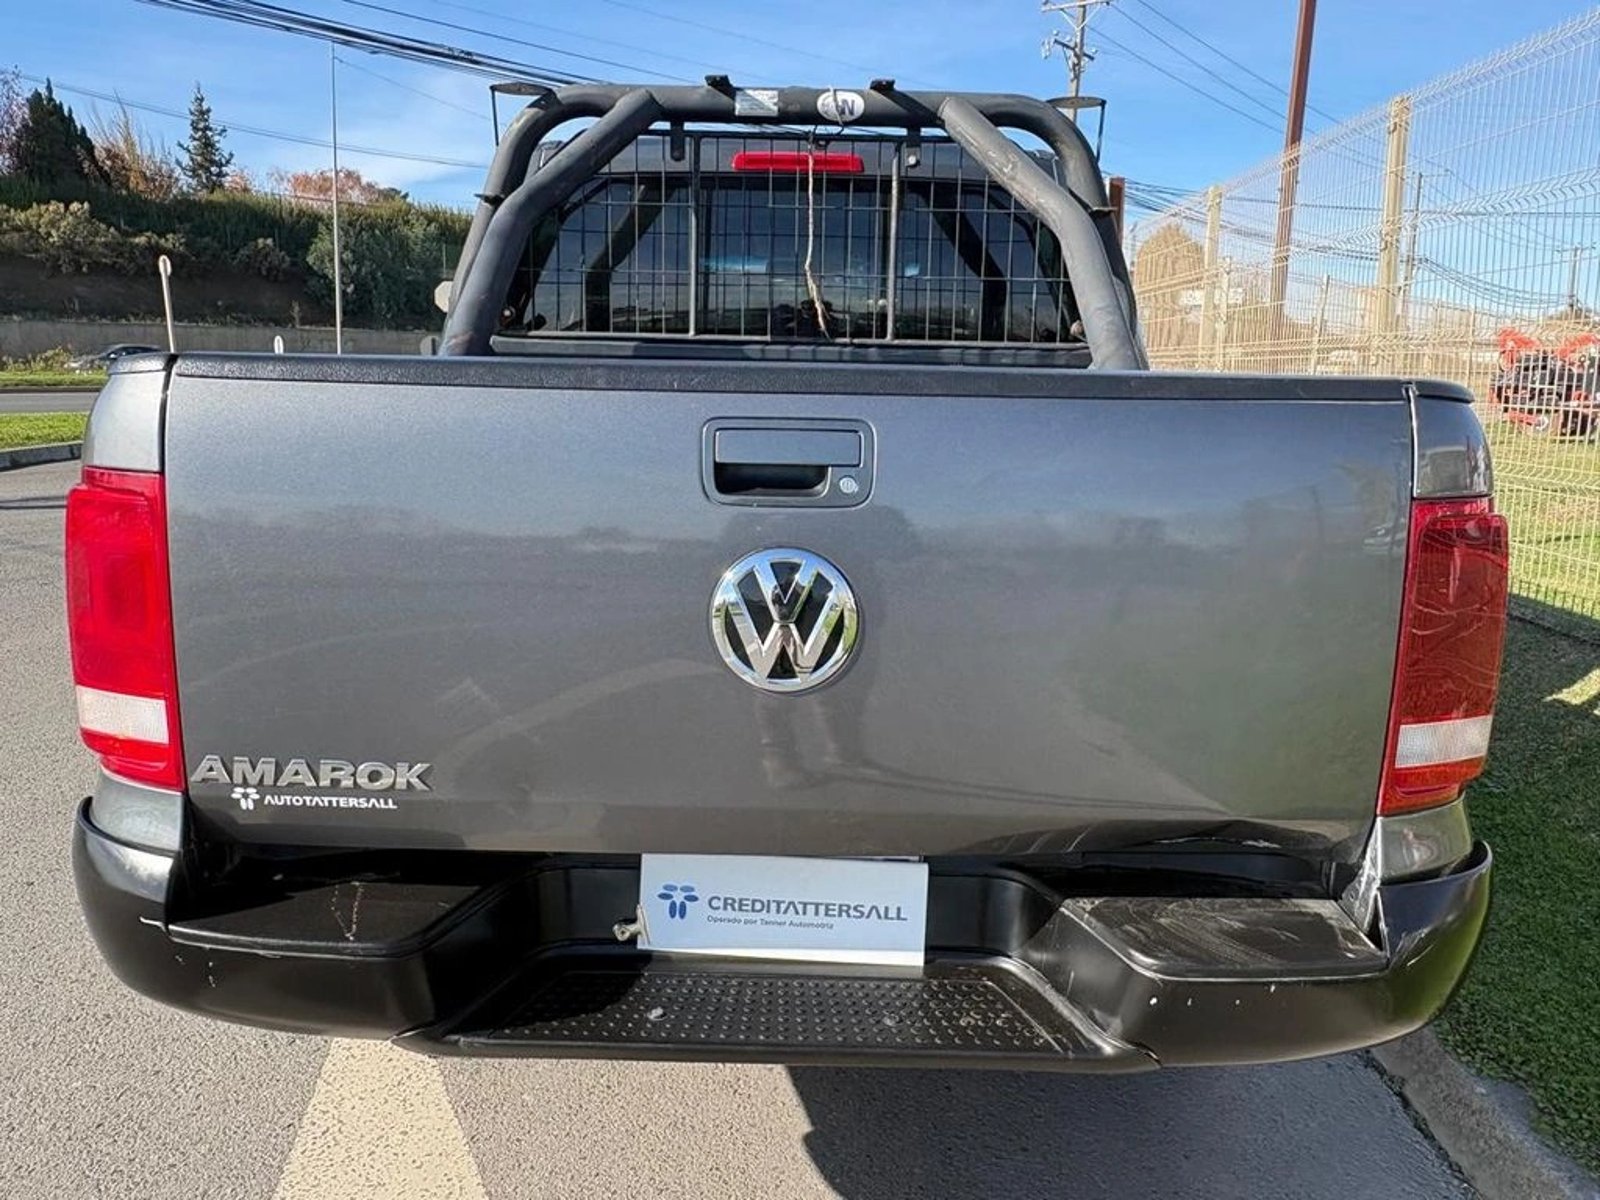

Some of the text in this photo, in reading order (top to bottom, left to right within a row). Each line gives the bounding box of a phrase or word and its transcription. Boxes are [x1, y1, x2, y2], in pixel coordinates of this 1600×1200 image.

[714, 550, 856, 691] VW
[190, 754, 432, 791] AMAROK
[264, 794, 398, 809] AUTOTATTERSALL
[707, 895, 908, 921] CREDITATTERSALL
